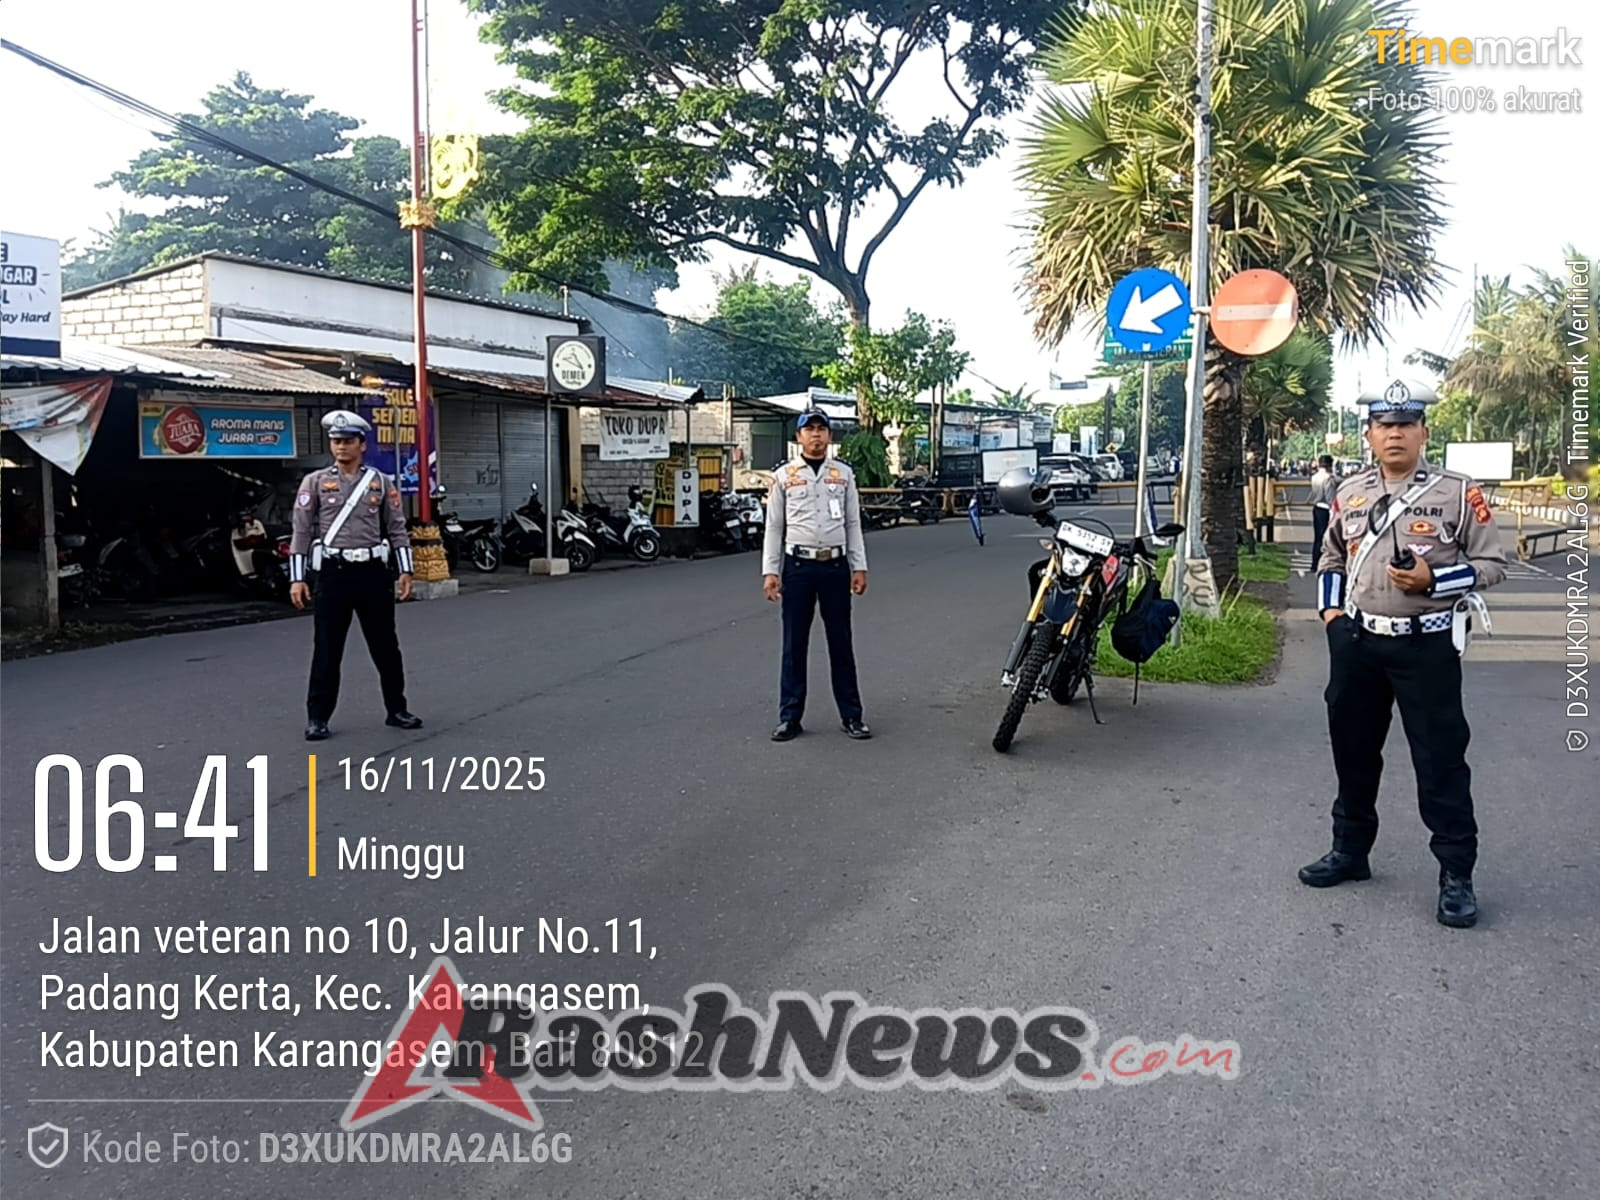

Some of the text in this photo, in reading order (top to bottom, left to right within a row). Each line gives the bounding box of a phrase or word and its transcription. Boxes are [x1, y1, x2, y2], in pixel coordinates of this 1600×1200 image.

[20, 311, 52, 323] Hard
[385, 388, 414, 406] SALE
[167, 420, 201, 440] JUARA
[211, 418, 286, 431] AROMA MANIS
[637, 415, 666, 436] DUPA
[218, 432, 254, 443] JUARA
[682, 470, 692, 522] DUPA
[1403, 506, 1444, 518] POLRI
